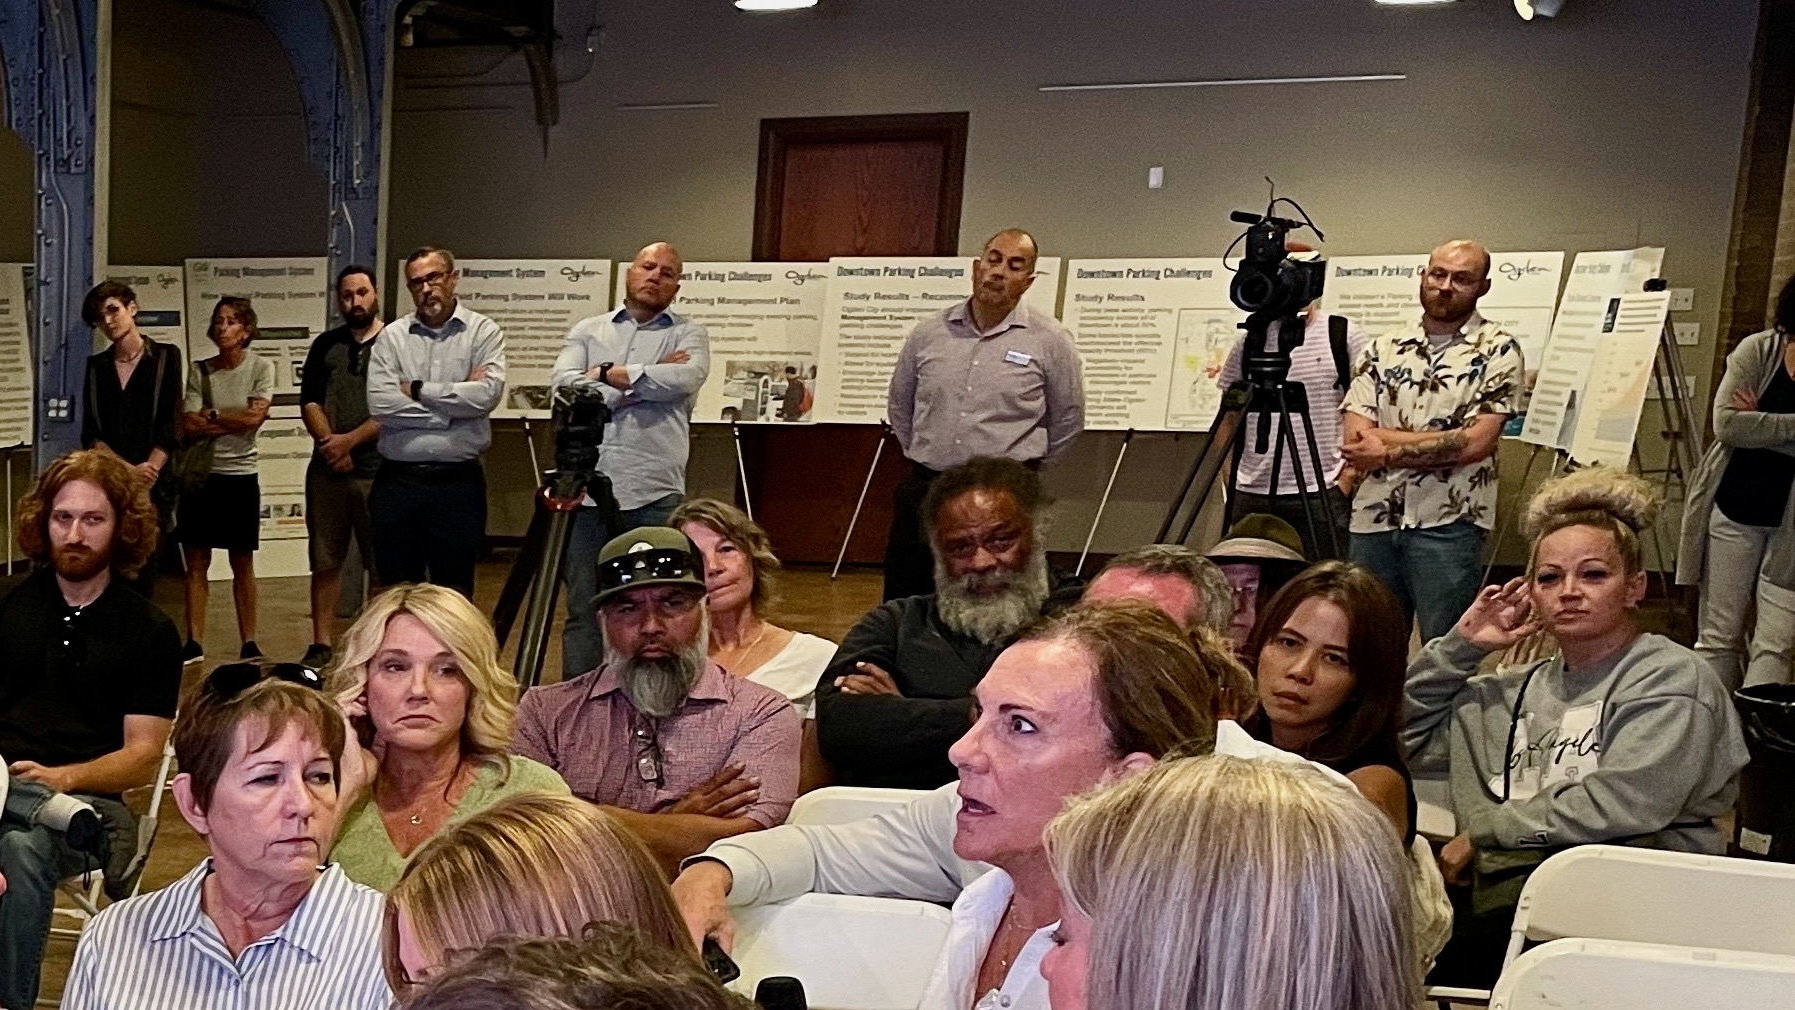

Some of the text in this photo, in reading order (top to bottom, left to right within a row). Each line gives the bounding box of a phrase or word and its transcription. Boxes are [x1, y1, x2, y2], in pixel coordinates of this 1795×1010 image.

[694, 270, 726, 282] Parking
[727, 270, 773, 283] Challenges
[836, 265, 965, 278] Downtown Parking Challenges
[1077, 267, 1213, 281] Downtown Parking Challenges
[1380, 265, 1415, 278] Parking
[716, 296, 778, 306] Management
[1107, 293, 1145, 302] Results
